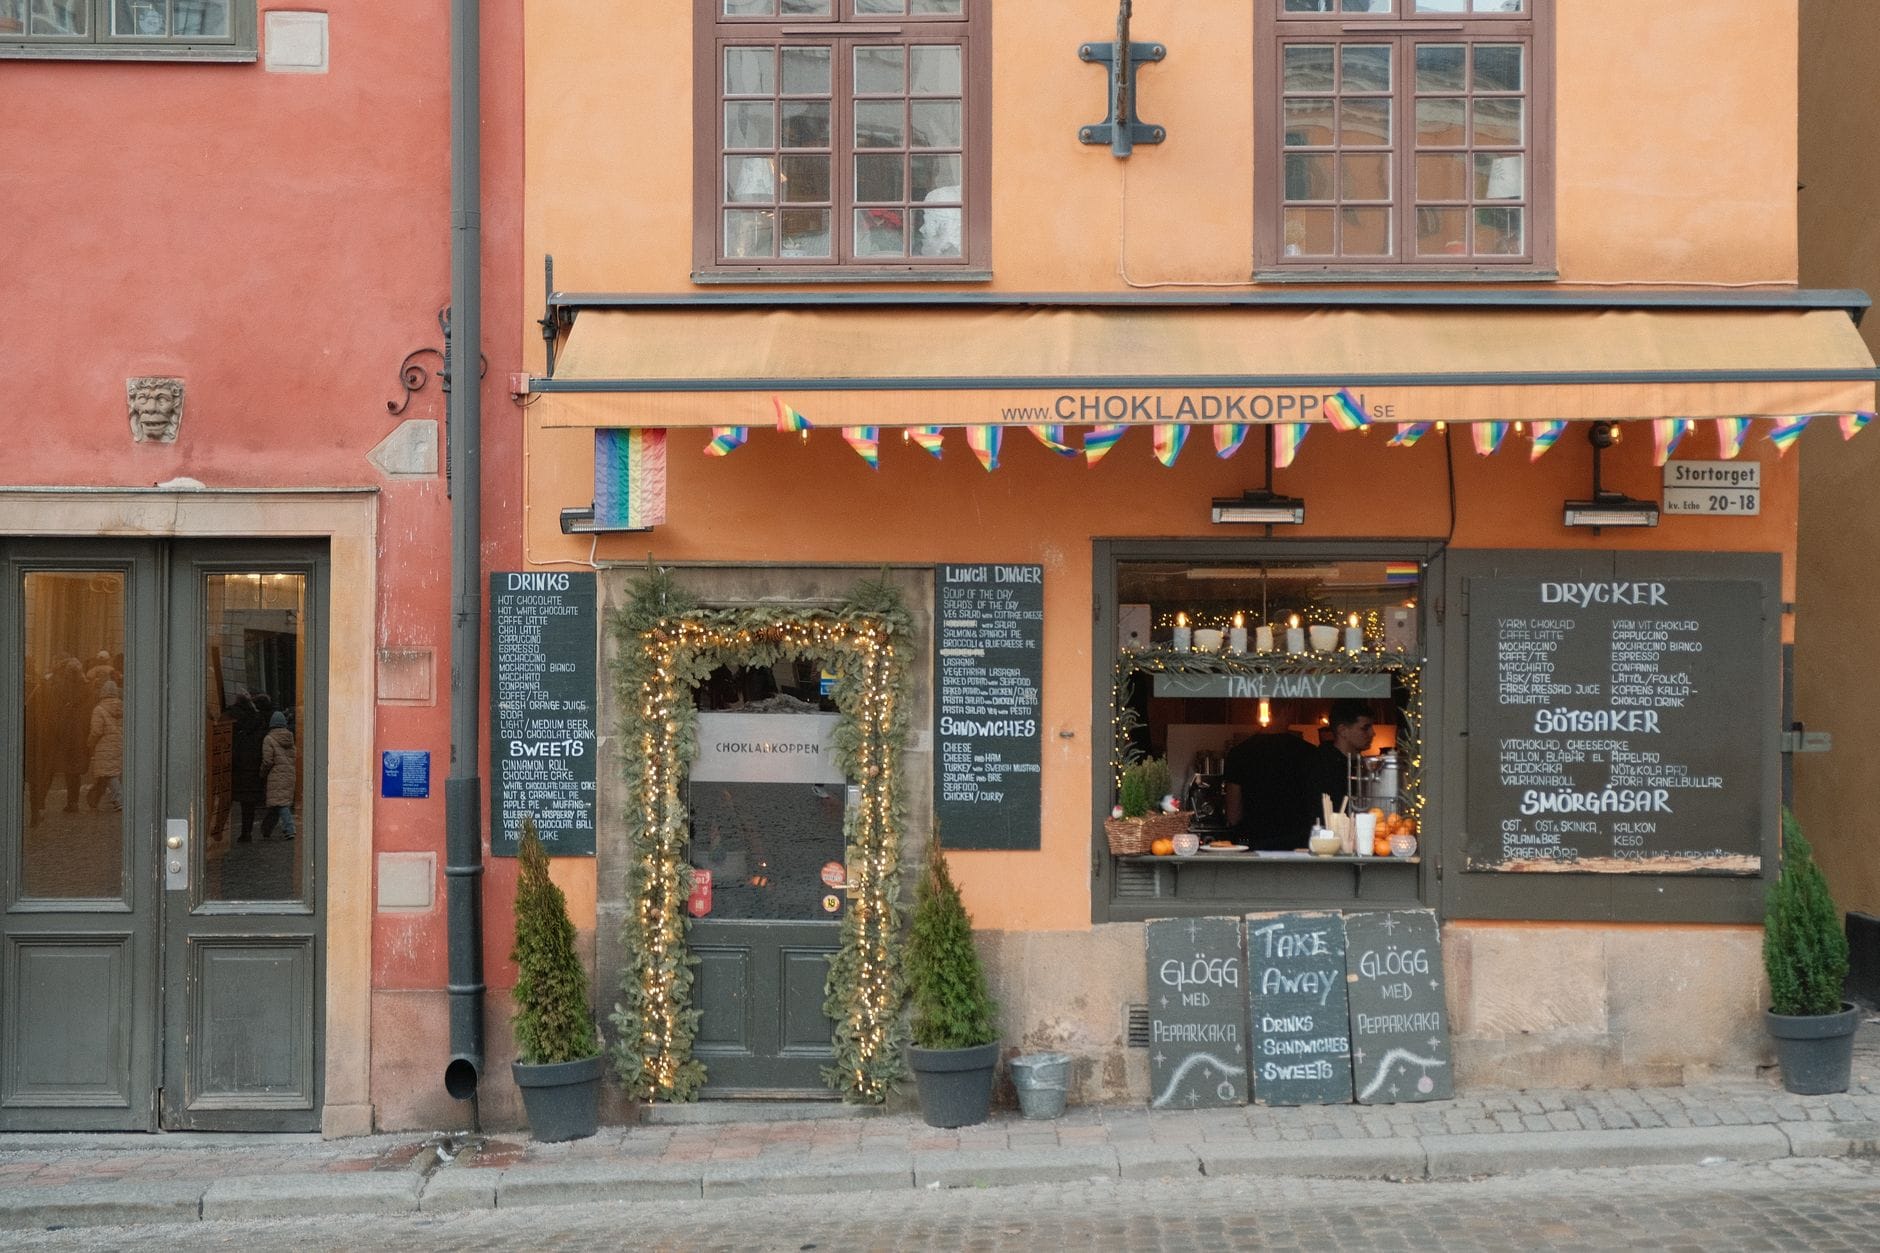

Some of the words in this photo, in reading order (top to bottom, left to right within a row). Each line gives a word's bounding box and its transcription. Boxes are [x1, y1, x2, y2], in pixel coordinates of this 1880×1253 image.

[1676, 465, 1755, 486] Stortorget
[1668, 501, 1680, 510] kv.
[1683, 501, 1700, 510] Echo
[1709, 495, 1755, 511] 20-18
[946, 566, 987, 582] LUNCH
[995, 566, 1041, 583] DINNER
[508, 573, 570, 591] DRINKS
[943, 587, 964, 599] SOUP
[967, 589, 976, 599] OF
[979, 589, 994, 599] THE
[997, 590, 1013, 600] DAY
[1541, 582, 1669, 608] DRYCKER
[498, 595, 514, 605] HOT
[516, 595, 562, 605] CHOCOLATE
[498, 606, 513, 616] HOT
[516, 606, 536, 616] WHITE
[539, 606, 579, 616] CHOCOLATE
[977, 601, 987, 609] OF
[989, 601, 1002, 610] THE
[1005, 601, 1019, 611] DAY
[943, 610, 957, 618] VEG
[959, 610, 981, 618] SALAD
[994, 610, 1022, 619] COTTAGE
[498, 615, 523, 625] CAFFE
[525, 615, 548, 625] LATTE
[994, 621, 1017, 629] SALAD
[1498, 619, 1527, 629] VARM
[1530, 619, 1575, 630] CHOKLAD
[498, 625, 517, 635] CHAI
[520, 625, 541, 635] LATTE
[1612, 620, 1635, 630] VARM
[1638, 621, 1652, 630] VIT
[1655, 621, 1699, 631] CHOKLAD
[499, 634, 541, 644] CAPPUCCINO
[979, 629, 1007, 638] SPINACH
[1011, 630, 1021, 639] PIE
[1499, 630, 1531, 640] CAFFE
[1535, 630, 1564, 640] LATTE
[1612, 631, 1668, 640] CAPPUCCINO
[499, 644, 540, 653] ESPRESSO
[943, 639, 977, 648] BROCCOLI
[1499, 641, 1557, 651] MOCHACCINO
[1612, 641, 1667, 651] MOCHACCINO
[1670, 641, 1702, 652] BIANCO
[499, 653, 546, 663] MOCHACCINO
[1611, 652, 1659, 661] ESPRESSO
[943, 658, 974, 667] LASAGNA
[1499, 662, 1555, 672] MACCHIATO
[1611, 662, 1658, 672] CONPANNA
[499, 663, 546, 672] MOCHACCINO
[549, 663, 576, 673] BIANCO
[943, 667, 986, 676] VEGETARIAN
[989, 668, 1020, 676] LASAGNA
[499, 672, 541, 682] MACCHIATO
[943, 676, 966, 685] BAKED
[1000, 677, 1031, 686] SEAFOOD
[499, 681, 540, 691] CONPANNA
[1222, 675, 1269, 697] TAKE
[1273, 675, 1326, 697] AWAY
[1576, 684, 1600, 694] JUICE
[1611, 685, 1653, 695] KOPPENS
[943, 696, 963, 705] PASTA
[964, 696, 984, 705] SALAD
[1611, 696, 1652, 706] CHOKLAD
[1655, 697, 1684, 707] DRINK
[499, 701, 526, 710] FRESH
[529, 701, 559, 710] ORANGE
[562, 701, 586, 711] JUICE
[942, 706, 964, 714] PASTA
[965, 706, 986, 715] SALAD
[1010, 707, 1031, 715] PESTO
[500, 710, 524, 720] SODA
[1534, 707, 1661, 733] SÖTSAKER
[567, 719, 589, 730] BEER
[940, 716, 1036, 737] SANDWICHES
[501, 729, 523, 739] COLD
[526, 729, 571, 739] CHOCOLATE
[573, 729, 596, 739] DRINK
[510, 740, 584, 757] SWEETS
[943, 742, 972, 752] CHEESE
[1567, 740, 1629, 751] CHEESECAKE
[943, 753, 972, 762] CHEESE
[985, 753, 1001, 762] HAM
[1546, 750, 1585, 762] BLÅBÄR
[1593, 753, 1604, 762] EL
[502, 759, 544, 771] CINNAMON
[548, 759, 568, 771] ROLL
[943, 763, 972, 772] TURKEY
[985, 764, 1012, 772] SWEDISH
[1501, 763, 1562, 773] KLADDKAKA
[502, 771, 548, 780] CHOCOLATE
[550, 771, 574, 780] CAKE
[1665, 765, 1687, 776] PAJ
[943, 773, 975, 782] SALAMIE
[987, 773, 1002, 782] BRIE
[1501, 775, 1575, 786] VALRHONABOLL
[1611, 775, 1643, 787] STORA
[1648, 777, 1722, 788] KANELBULLAR
[502, 781, 523, 790] WHITE
[525, 781, 558, 790] CHOCOLATE
[943, 783, 978, 792] SEAFOOD
[503, 791, 518, 800] NUT
[520, 791, 526, 800] &
[528, 791, 566, 800] CARAMELL
[569, 791, 579, 800] PIE
[1521, 784, 1673, 815] SMÖRGÅSAR
[503, 800, 526, 809] APPLE
[576, 810, 588, 819] PIE
[538, 819, 573, 829] CHOCOLATE
[576, 819, 593, 829] BALL
[1614, 822, 1656, 833] KALKON
[1614, 835, 1643, 846] KESO
[1255, 923, 1332, 958] TAKE
[1361, 945, 1429, 980] GLÖGG
[1161, 953, 1238, 992] GLÖGG
[1263, 968, 1338, 1006] AWAY
[1382, 982, 1412, 1001] MED
[1182, 992, 1210, 1007] MED
[1262, 1015, 1313, 1033] DRINKS
[1358, 1012, 1439, 1035] PEPPARKAKA
[1154, 1020, 1236, 1042] PEPPARKAKA
[1264, 1037, 1349, 1055] SANDWICHES
[1264, 1060, 1333, 1080] SWEETS
